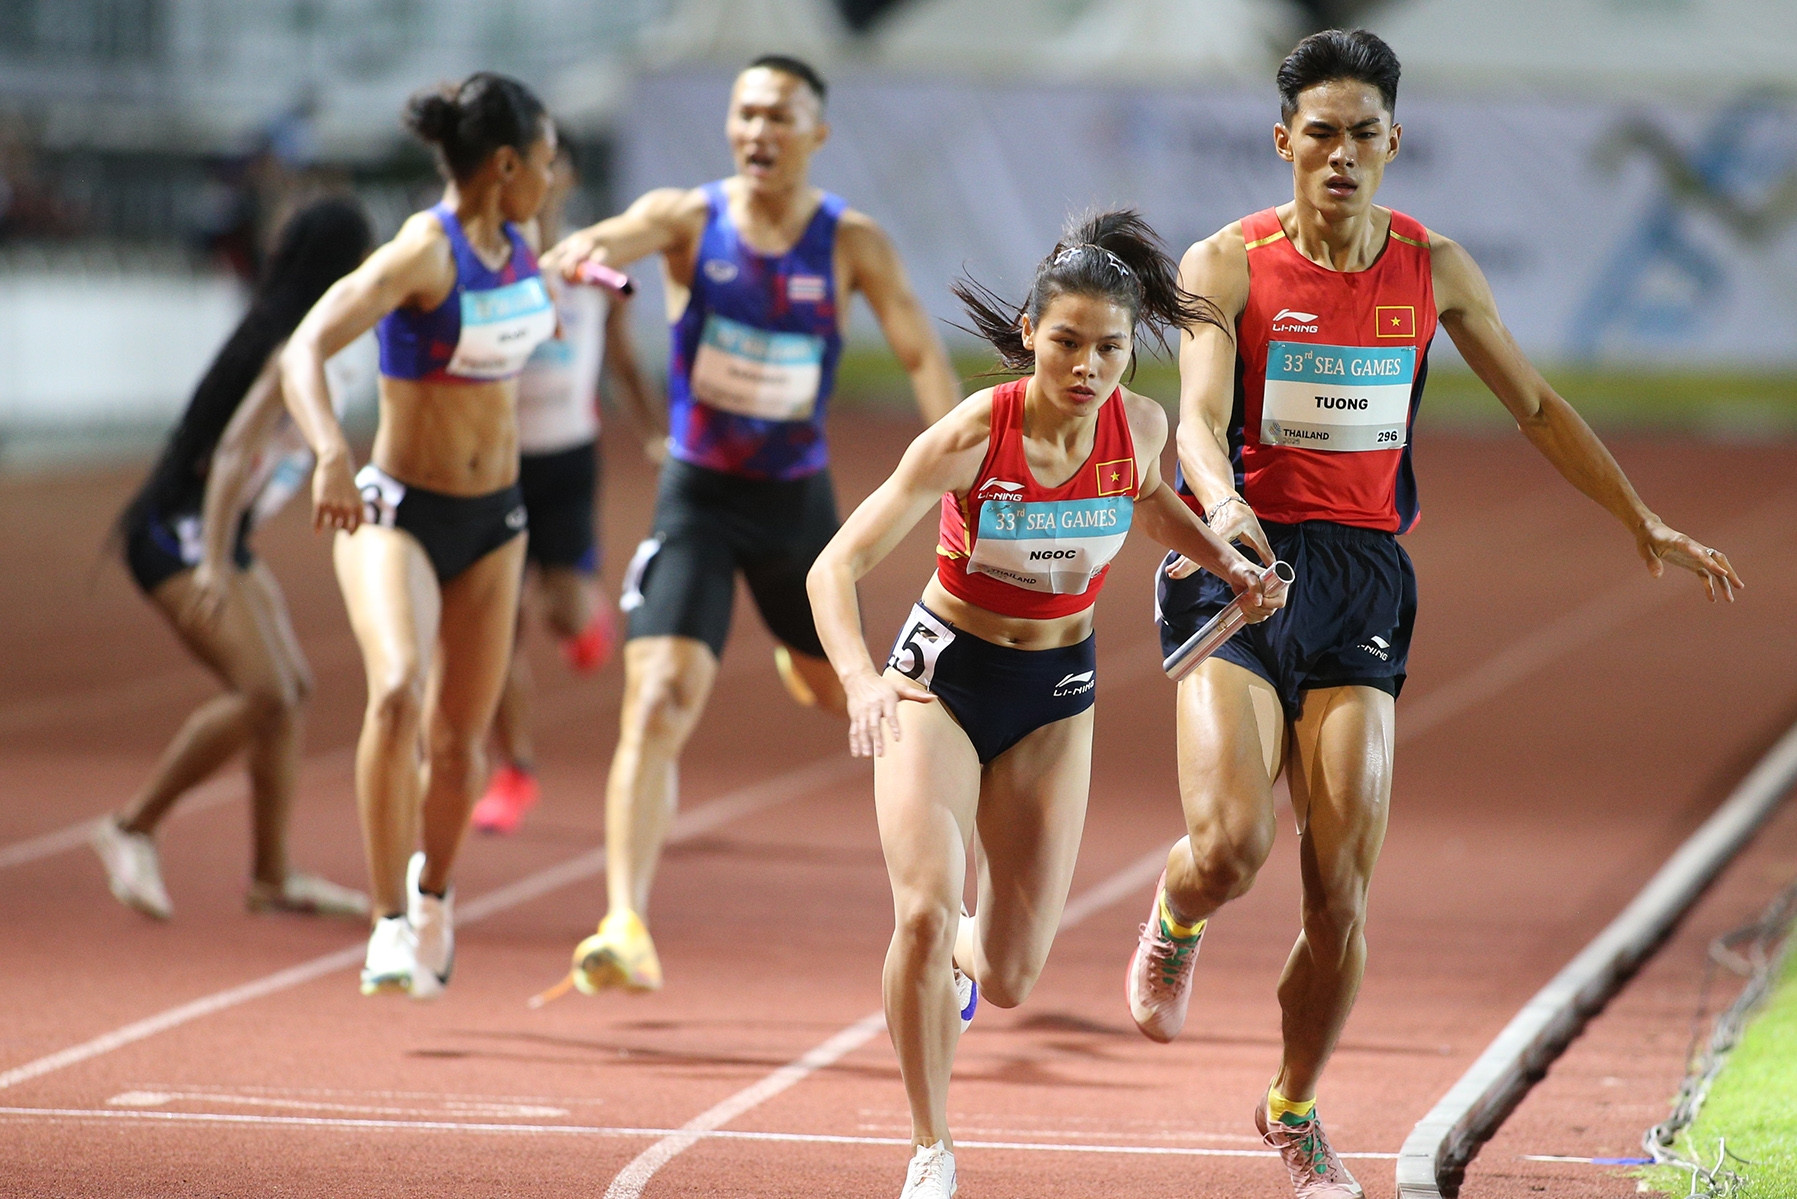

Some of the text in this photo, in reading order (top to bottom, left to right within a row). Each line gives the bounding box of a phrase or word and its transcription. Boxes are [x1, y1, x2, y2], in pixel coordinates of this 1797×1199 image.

[1272, 323, 1319, 333] LI-NING
[1314, 356, 1345, 376] SEA
[1350, 358, 1401, 376] GAMES
[1314, 396, 1369, 410] TUONG
[1283, 428, 1398, 442] THAILAND 296
[977, 492, 1023, 502] LI-NING
[1026, 512, 1056, 531] SEA
[1061, 508, 1117, 528] GAMES
[1029, 550, 1076, 561] NGOC
[892, 621, 940, 680] 5
